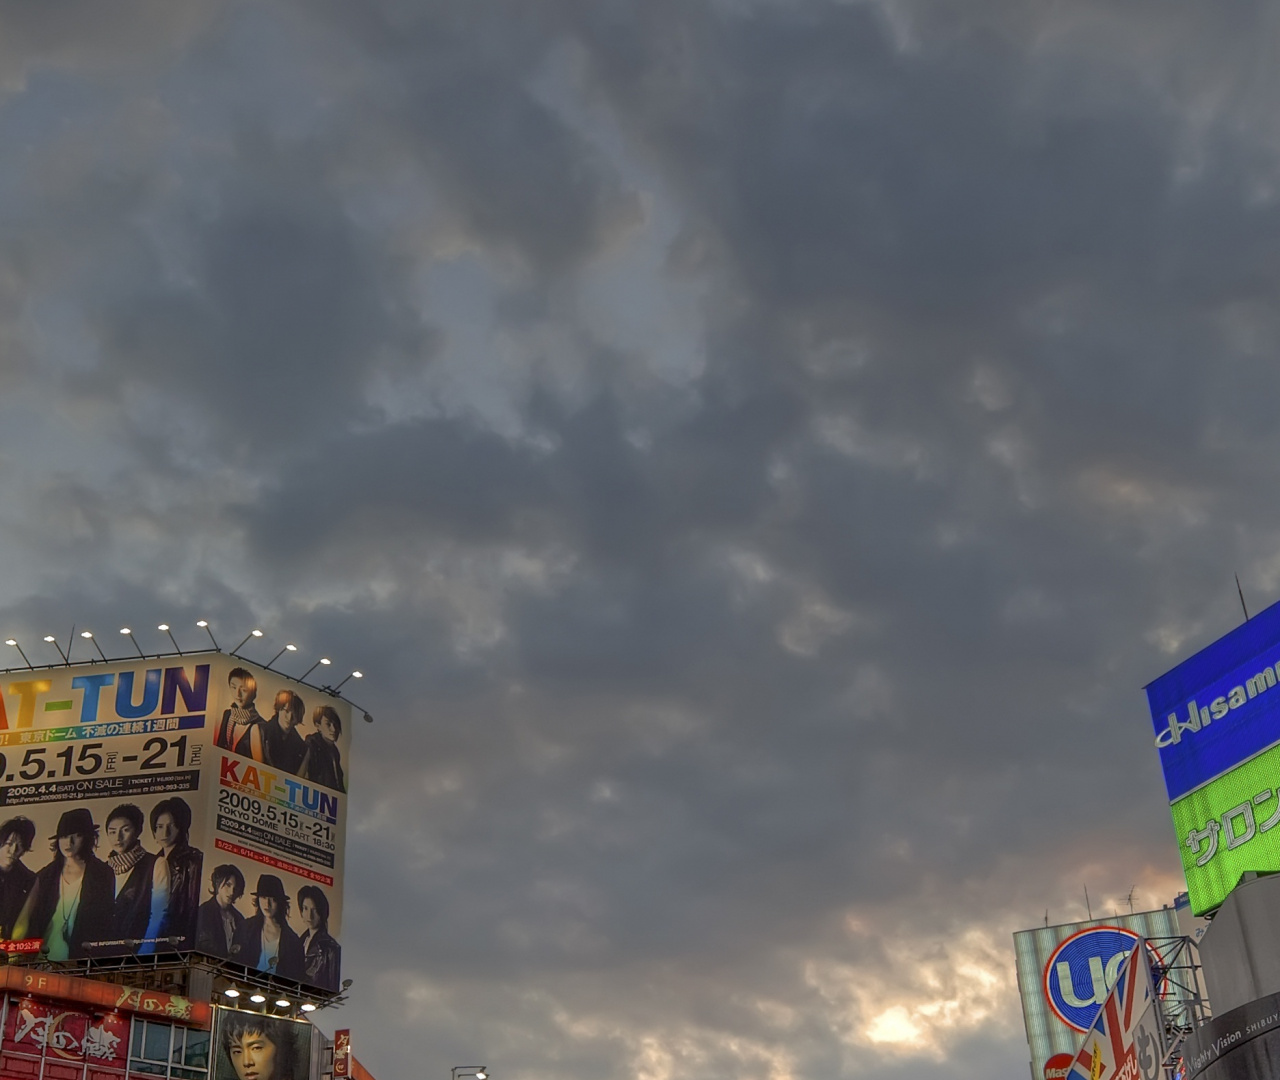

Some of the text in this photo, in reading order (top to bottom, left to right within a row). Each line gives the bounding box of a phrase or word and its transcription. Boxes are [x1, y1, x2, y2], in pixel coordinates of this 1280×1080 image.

[20, 727, 77, 743] 東京ドーム
[82, 716, 179, 737] 不滅の連続1週間
[76, 781, 94, 791] ON
[96, 779, 123, 789] SALE
[221, 756, 338, 818] KAT-TUN
[218, 789, 299, 828] 2009.5.15
[218, 805, 335, 850] TOKYO DOME START 18:30
[1186, 1050, 1211, 1073] Mighty
[1212, 1029, 1243, 1057] Vision
